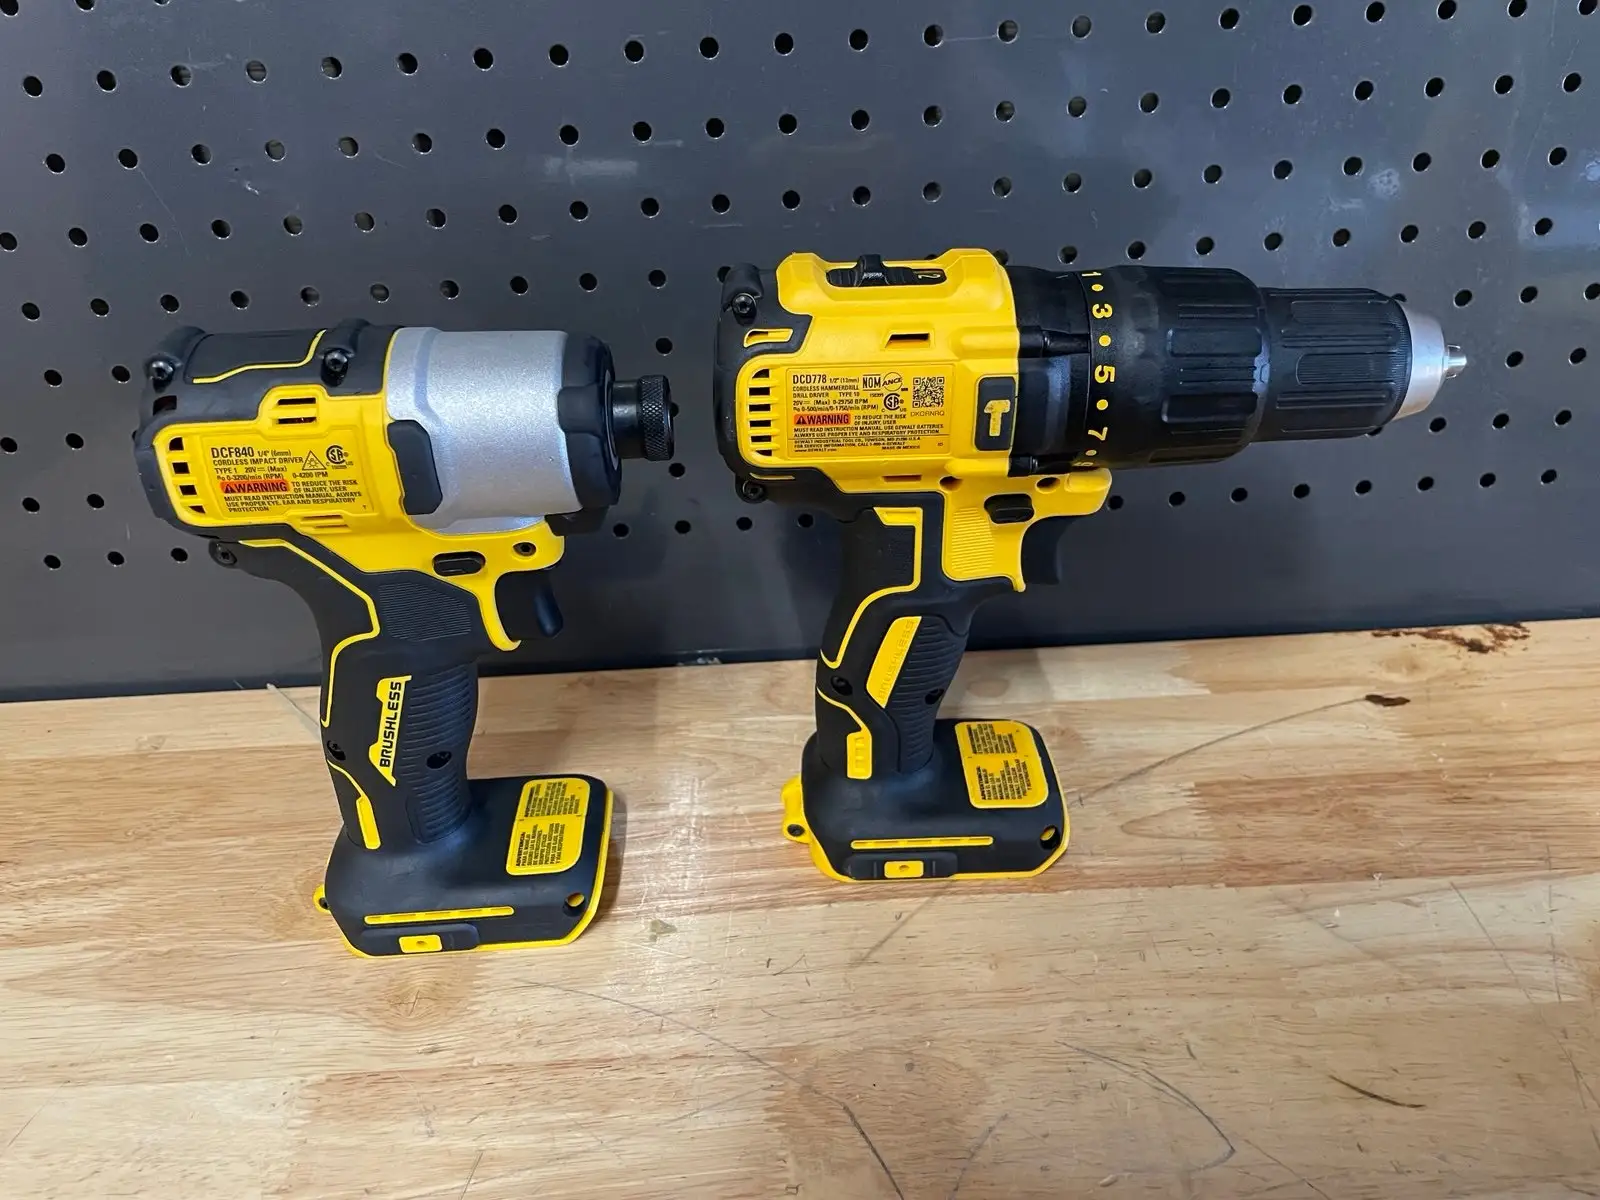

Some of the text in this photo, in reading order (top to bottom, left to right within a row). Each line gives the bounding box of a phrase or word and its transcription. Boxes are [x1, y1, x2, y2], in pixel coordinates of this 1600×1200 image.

[1092, 304, 1112, 319] 3
[792, 374, 826, 384] DCD778
[1094, 364, 1116, 384] 5
[862, 376, 881, 388] NOM
[882, 376, 902, 386] ANCE
[807, 414, 849, 424] WARNING
[1088, 427, 1108, 441] 7
[210, 446, 254, 458] DCF840
[235, 482, 288, 494] WARNING
[380, 682, 402, 768] BRUSHLESS
